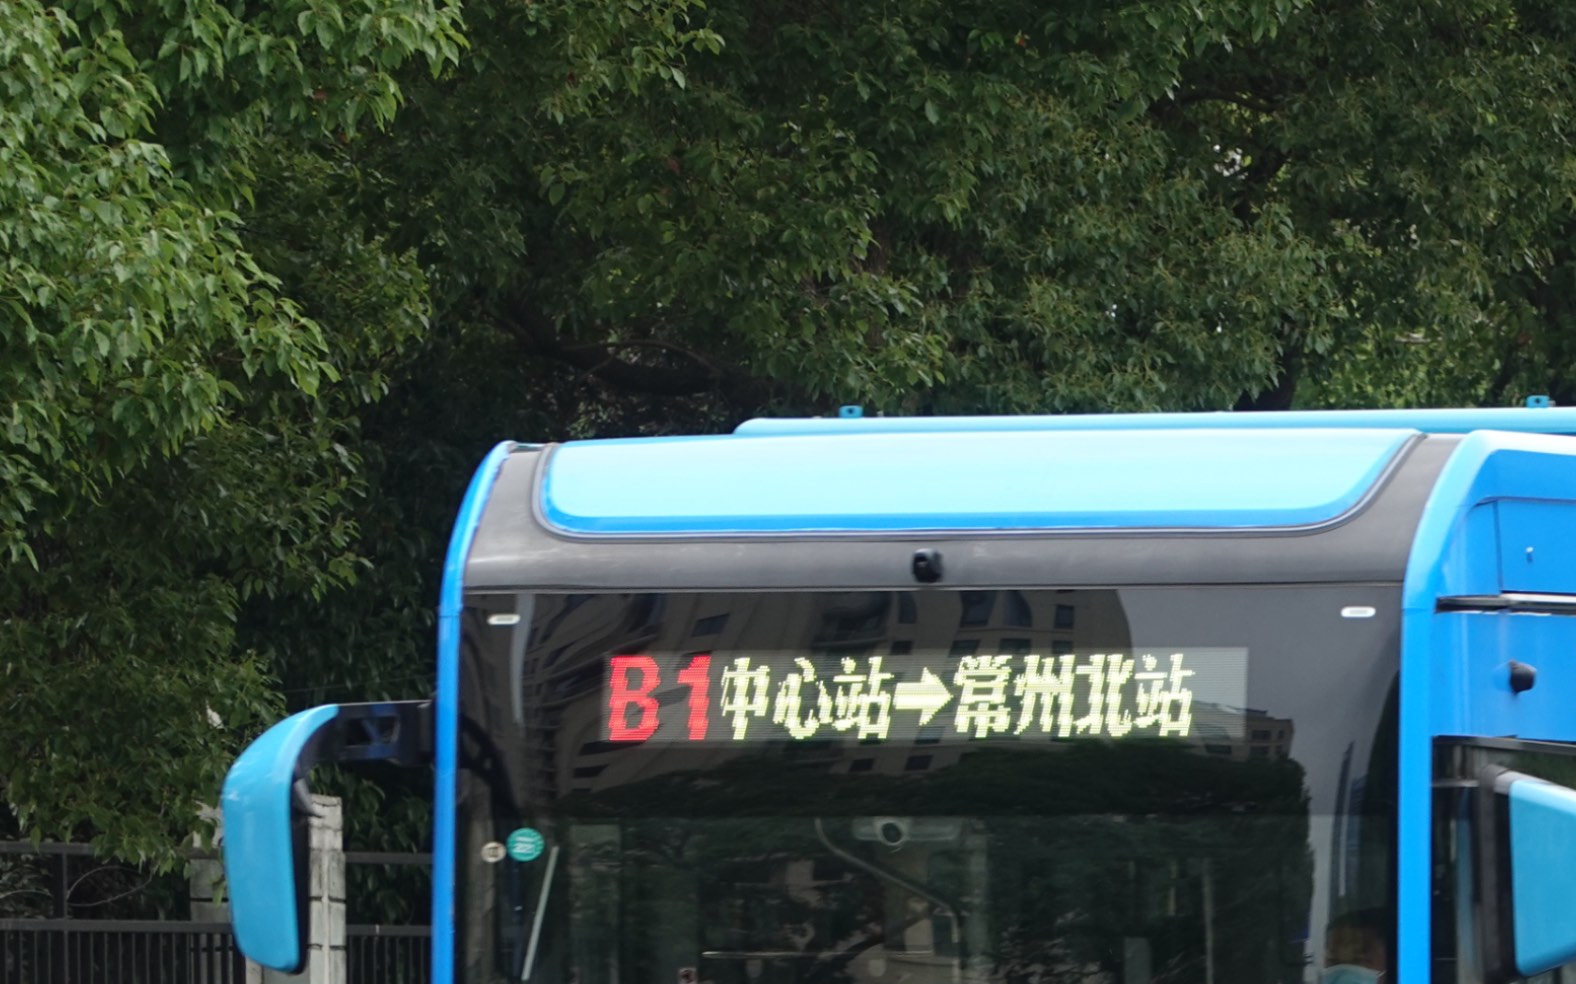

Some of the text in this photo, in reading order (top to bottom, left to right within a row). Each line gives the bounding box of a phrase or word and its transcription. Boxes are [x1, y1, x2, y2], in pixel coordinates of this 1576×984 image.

[608, 653, 1195, 741] B1 中心站 常州北站
